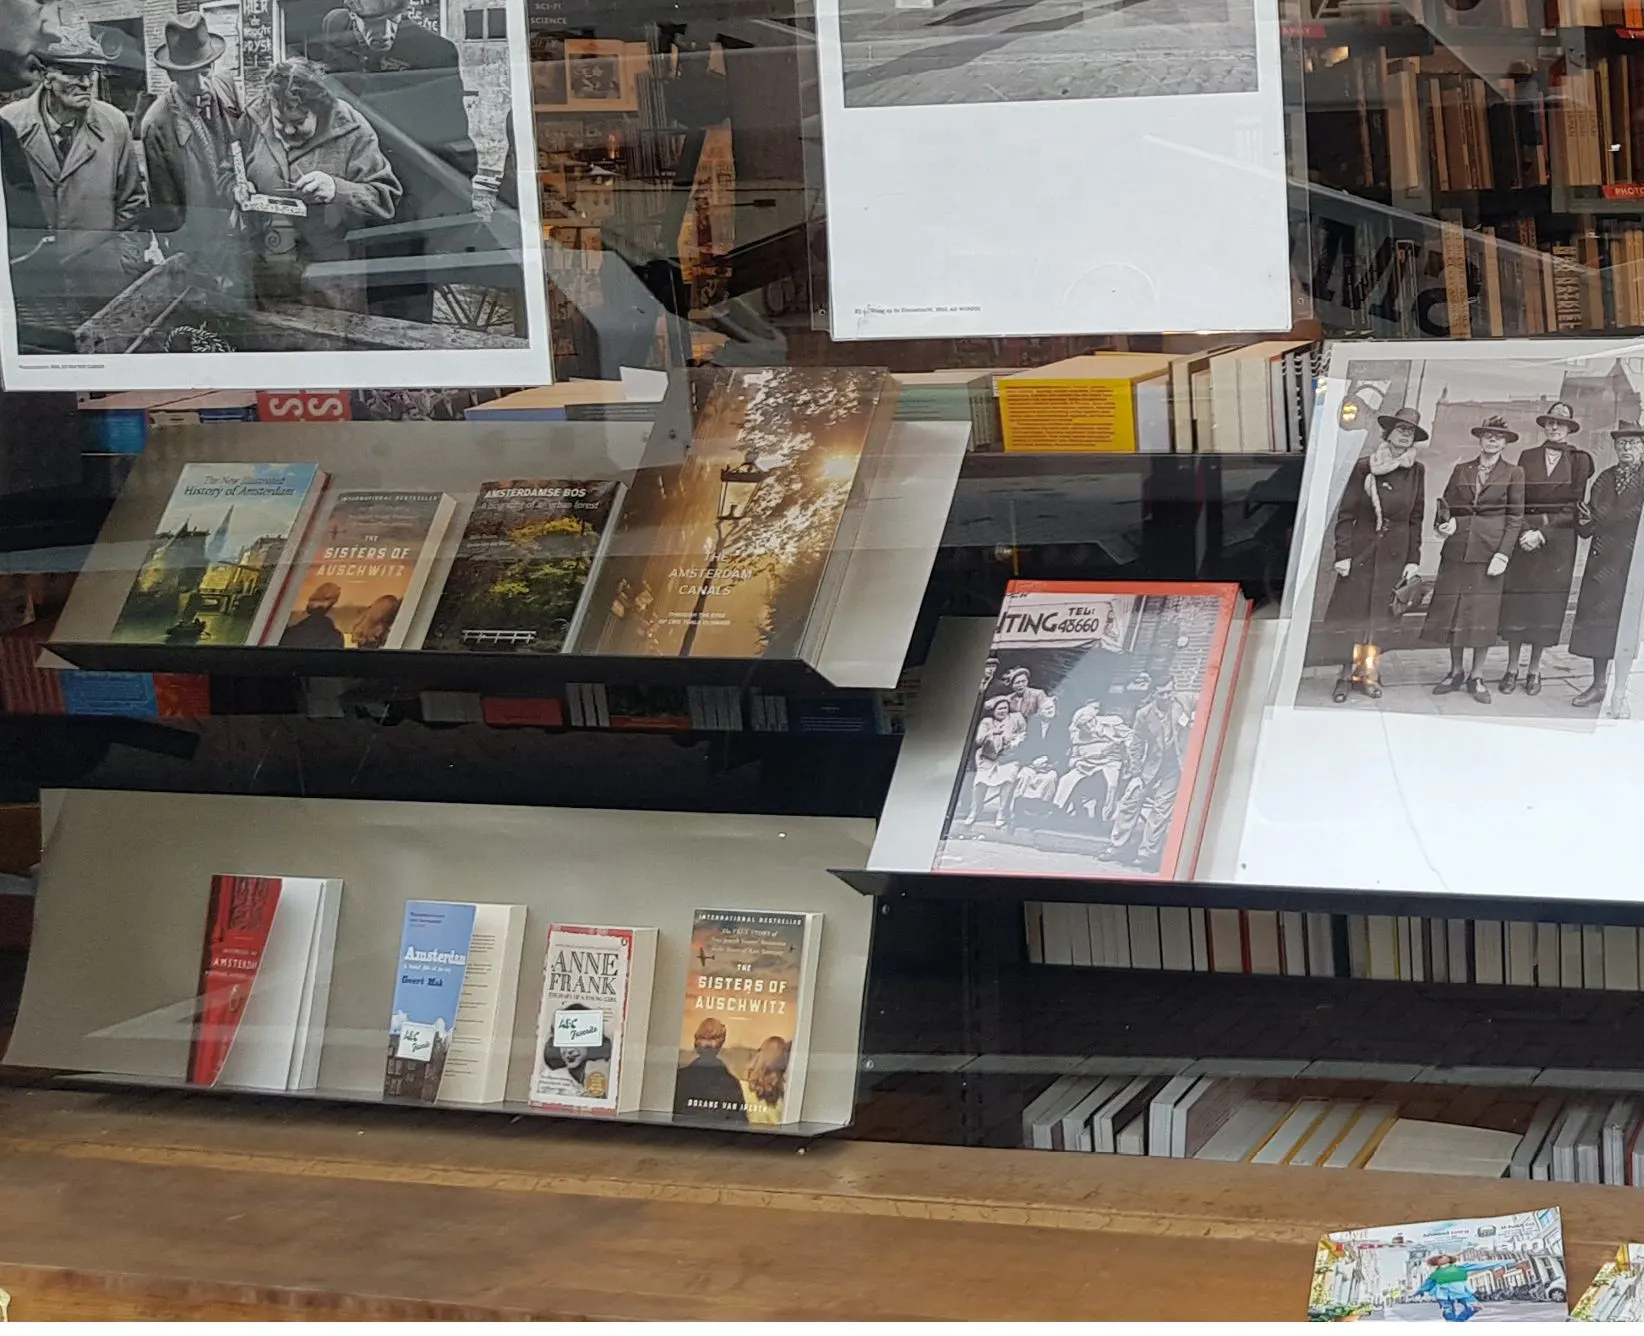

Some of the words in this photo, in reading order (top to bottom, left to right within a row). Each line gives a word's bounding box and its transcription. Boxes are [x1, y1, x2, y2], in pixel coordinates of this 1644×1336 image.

[529, 16, 568, 26] SCIENCE
[184, 485, 222, 499] History
[225, 485, 239, 496] of
[239, 486, 294, 497] Amsterdam
[484, 487, 562, 498] AMSTERDAMSE
[562, 487, 587, 497] BOS
[526, 500, 536, 509] of
[574, 500, 600, 510] forest
[323, 547, 387, 560] SISTERS
[390, 547, 411, 560] OF
[704, 552, 728, 562] THE
[316, 564, 406, 577] AUSCHWITZ
[668, 568, 753, 580] AMSTERDAM
[678, 584, 733, 596] CANALS
[1068, 606, 1096, 617] TEL:
[1057, 617, 1100, 633] 48660
[698, 914, 756, 924] INTERNATIONAL
[758, 916, 802, 926] BESTSELLER
[551, 949, 619, 976] ANNE
[737, 963, 752, 972] THE
[549, 972, 617, 995] FRANK
[698, 975, 764, 993] SISTERS
[768, 980, 788, 994] OF
[695, 995, 787, 1015] AUSCHWITZ
[722, 1101, 738, 1110] VAN
